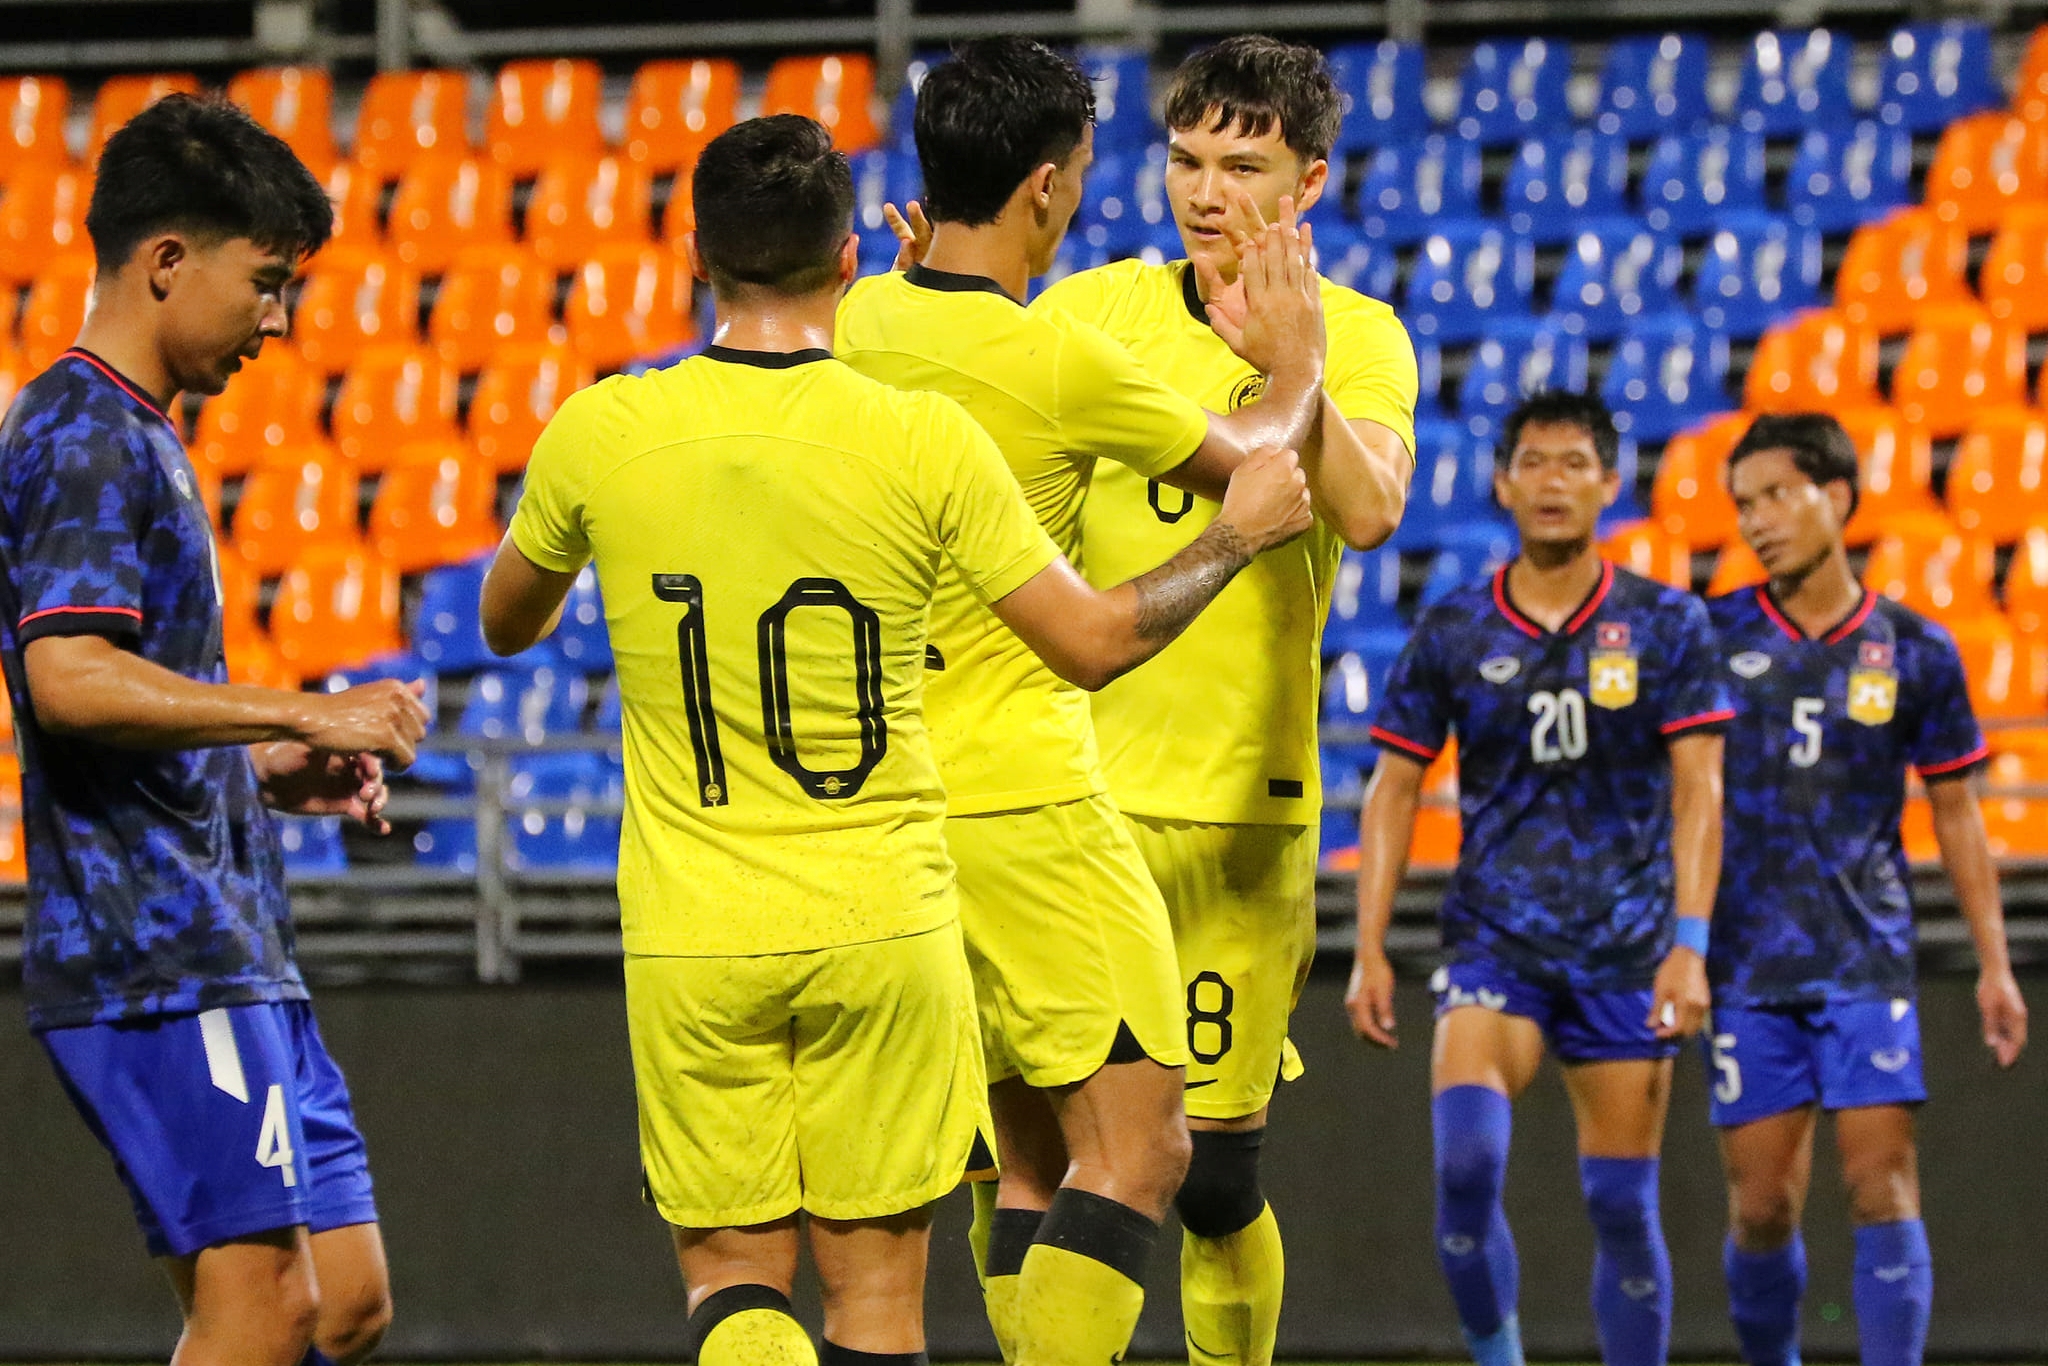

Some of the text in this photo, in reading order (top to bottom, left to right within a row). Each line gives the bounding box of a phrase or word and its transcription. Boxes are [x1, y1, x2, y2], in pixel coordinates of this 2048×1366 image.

[652, 573, 888, 808] 10
[1527, 688, 1589, 763] 20
[1788, 697, 1826, 768] 5
[1186, 971, 1233, 1065] 8
[1713, 1033, 1742, 1104] 5
[255, 1084, 297, 1188] 4
